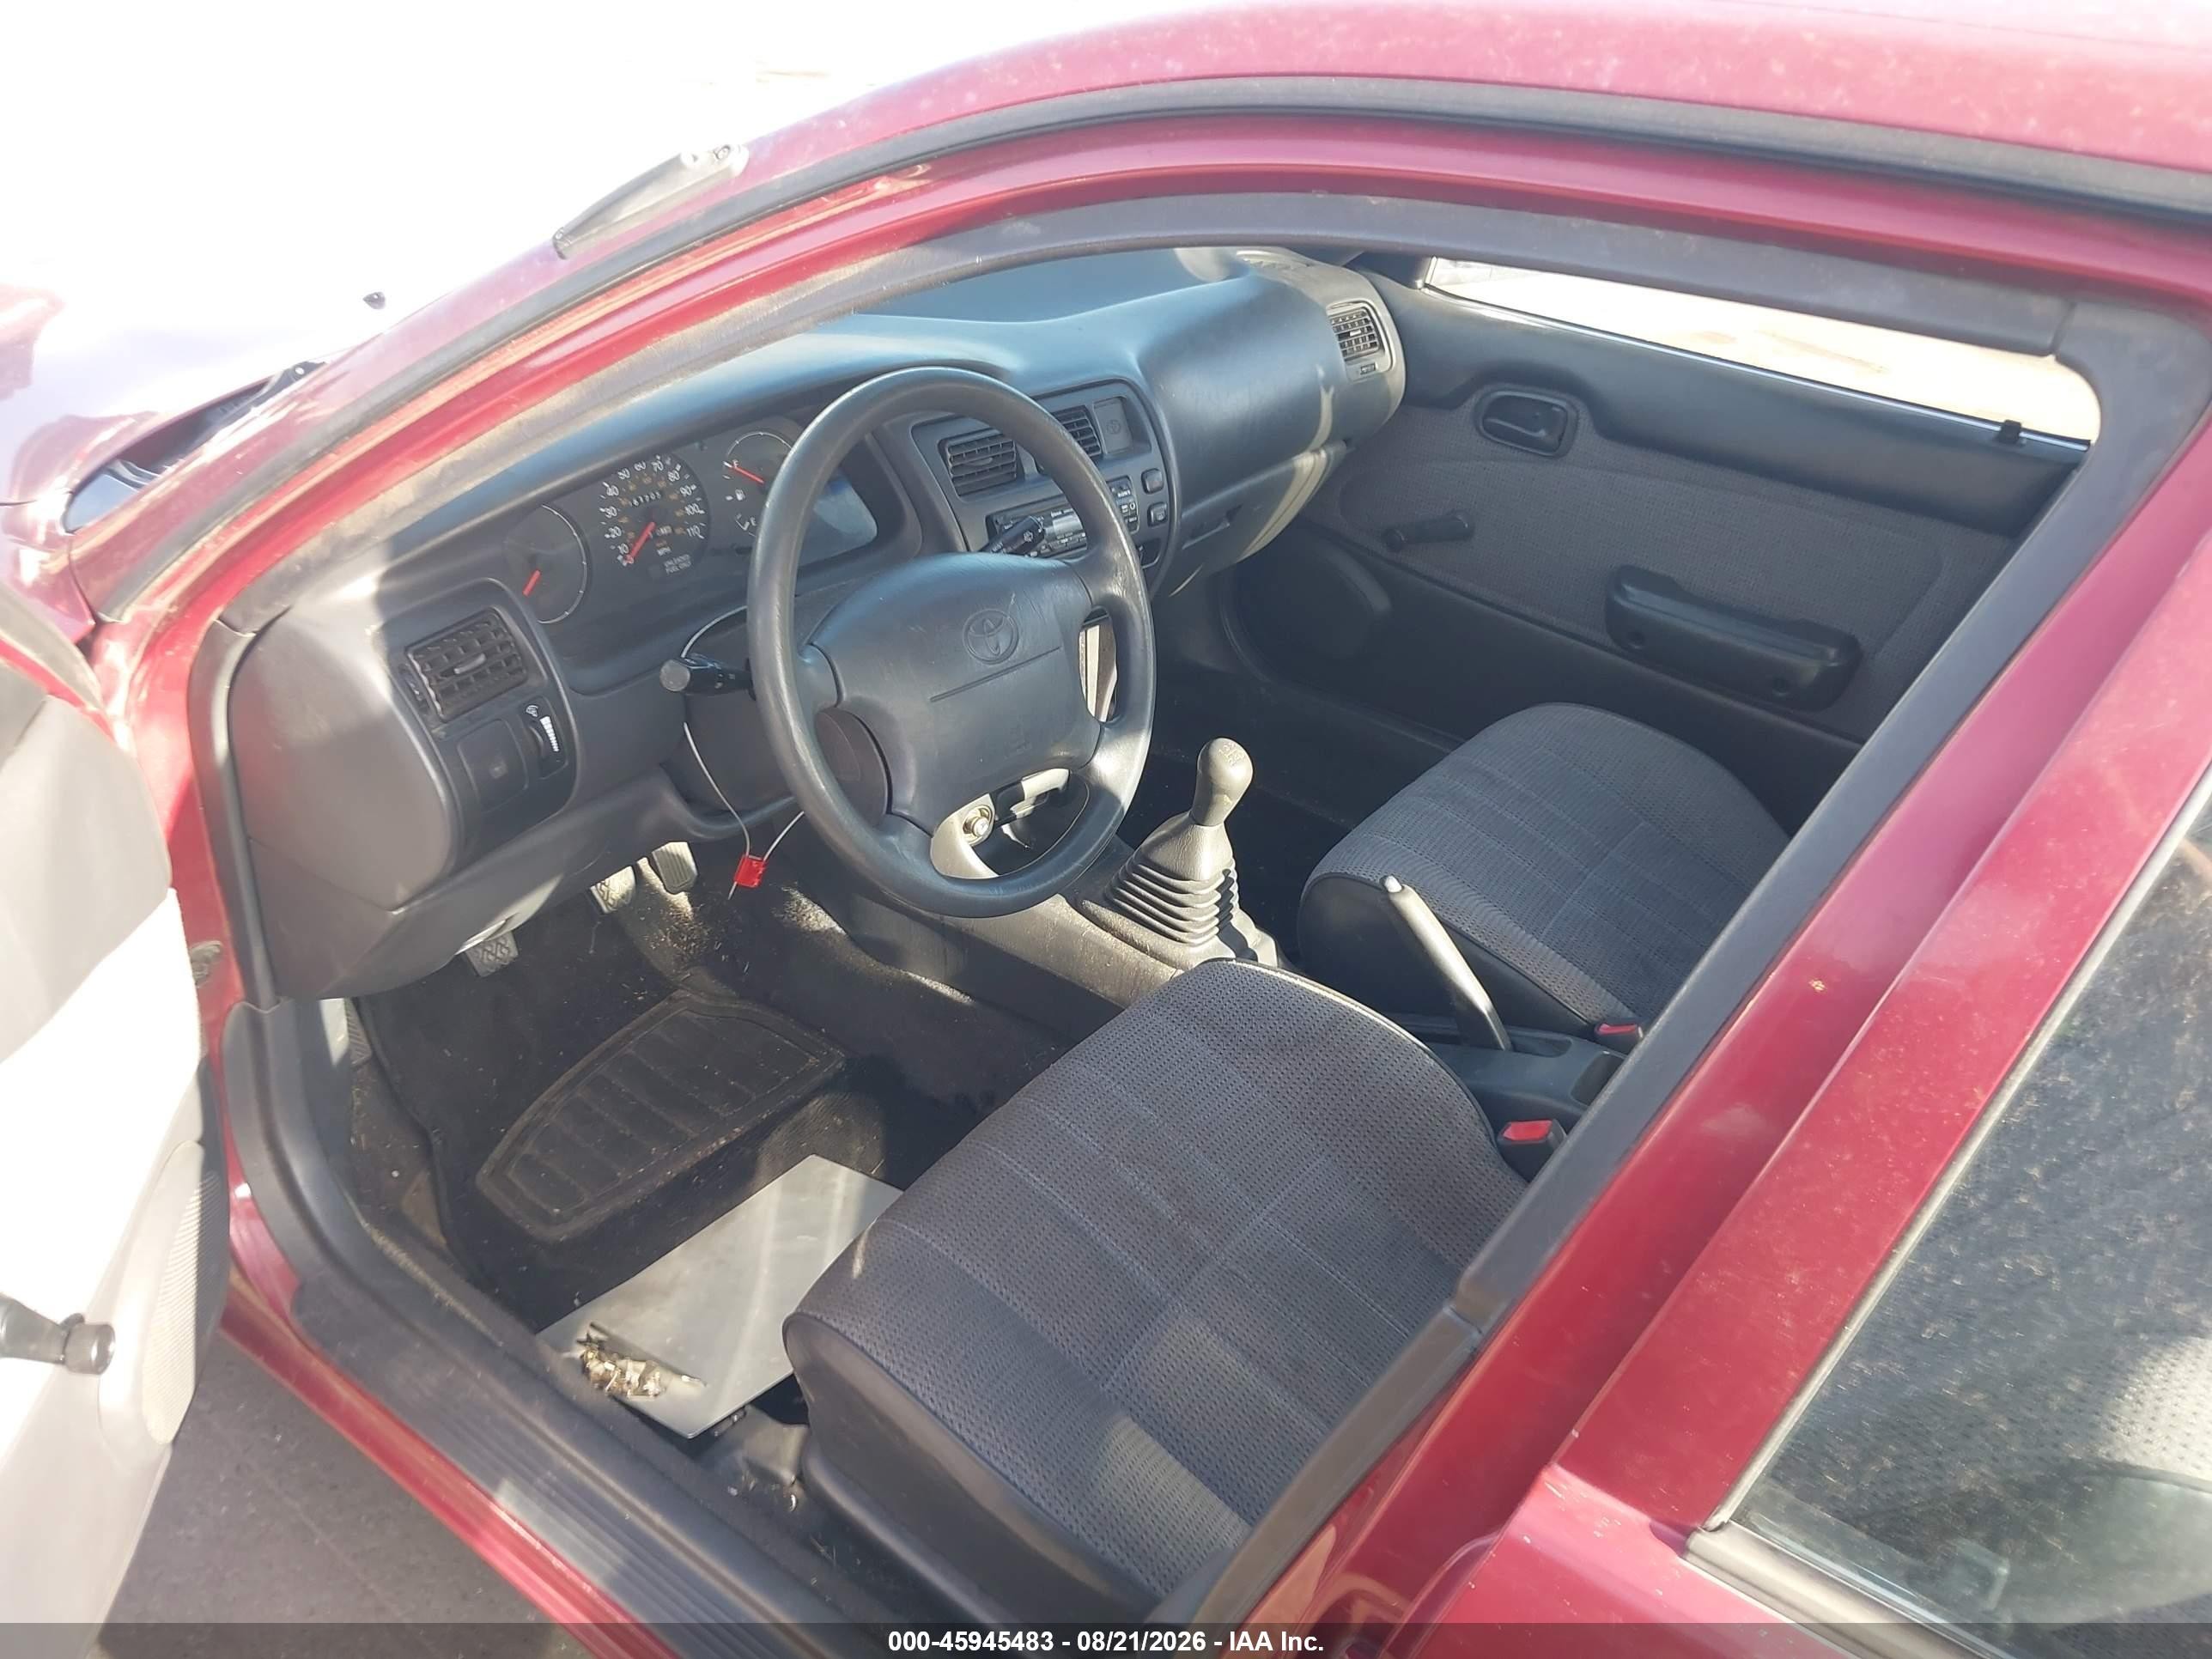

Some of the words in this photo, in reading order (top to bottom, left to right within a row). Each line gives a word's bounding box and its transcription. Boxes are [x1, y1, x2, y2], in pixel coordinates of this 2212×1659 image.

[651, 459, 664, 472] 70
[668, 469, 680, 482] 80
[679, 484, 692, 496] 90
[605, 505, 617, 518] 30
[684, 502, 700, 516] 100
[608, 526, 622, 538] 20
[686, 524, 700, 538] 110
[617, 543, 629, 554] 10
